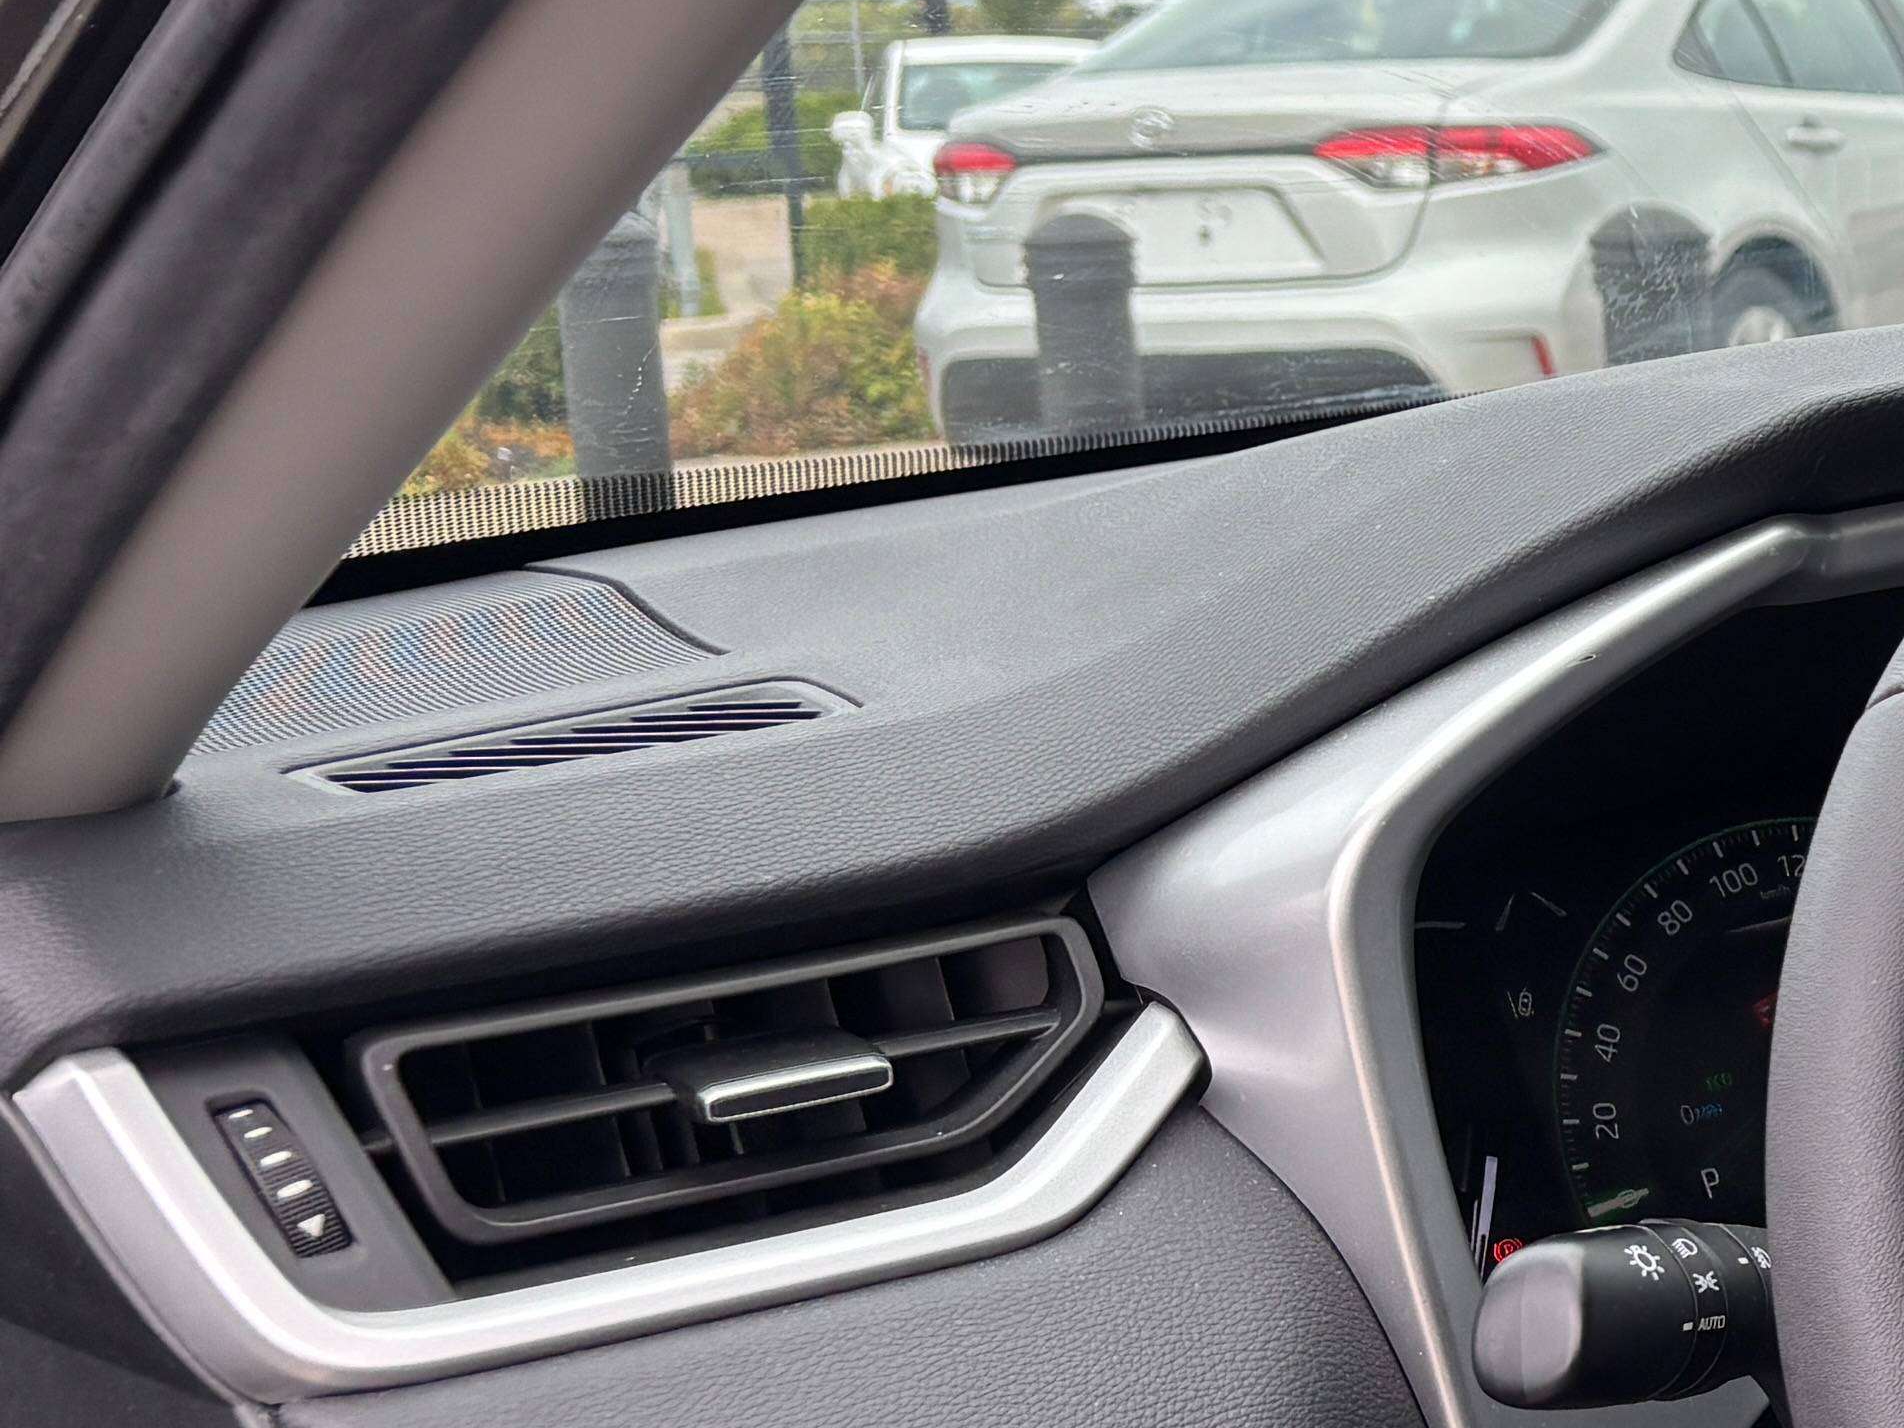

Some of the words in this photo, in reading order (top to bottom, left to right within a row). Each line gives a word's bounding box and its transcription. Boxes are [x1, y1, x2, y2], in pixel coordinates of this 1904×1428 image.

[1708, 861, 1760, 898] 100
[1656, 898, 1694, 937] 80
[1616, 953, 1649, 993] 60
[1594, 1022, 1622, 1064] 40
[1595, 1101, 1619, 1141] 20
[1700, 1166, 1720, 1200] P
[1697, 1314, 1727, 1332] AUTO
